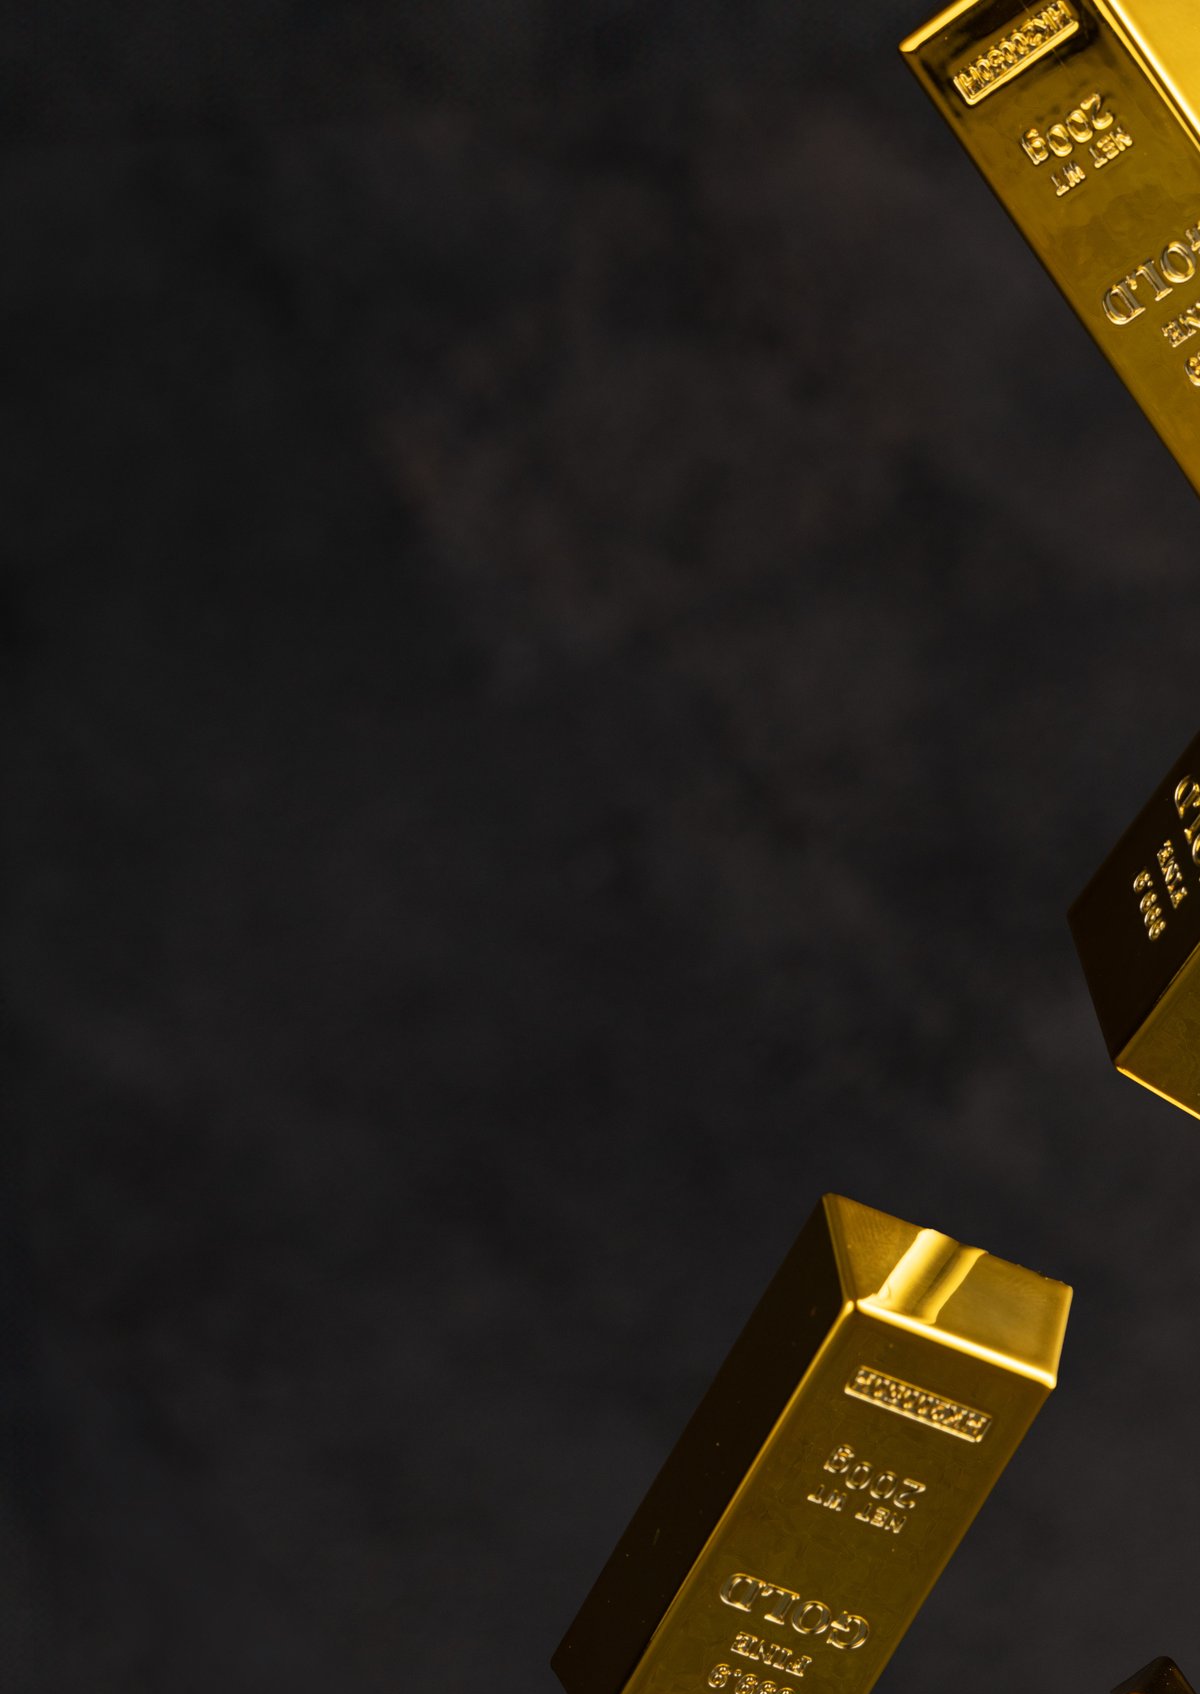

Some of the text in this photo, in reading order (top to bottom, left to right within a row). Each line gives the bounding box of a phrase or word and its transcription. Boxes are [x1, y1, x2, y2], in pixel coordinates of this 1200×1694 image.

[1020, 92, 1113, 165] 200g
[1051, 126, 1133, 197] NET WT
[807, 1484, 907, 1534] NET WT
[824, 1444, 926, 1509] 200g
[719, 1573, 870, 1649] GOLD
[731, 1631, 812, 1676] FINE
